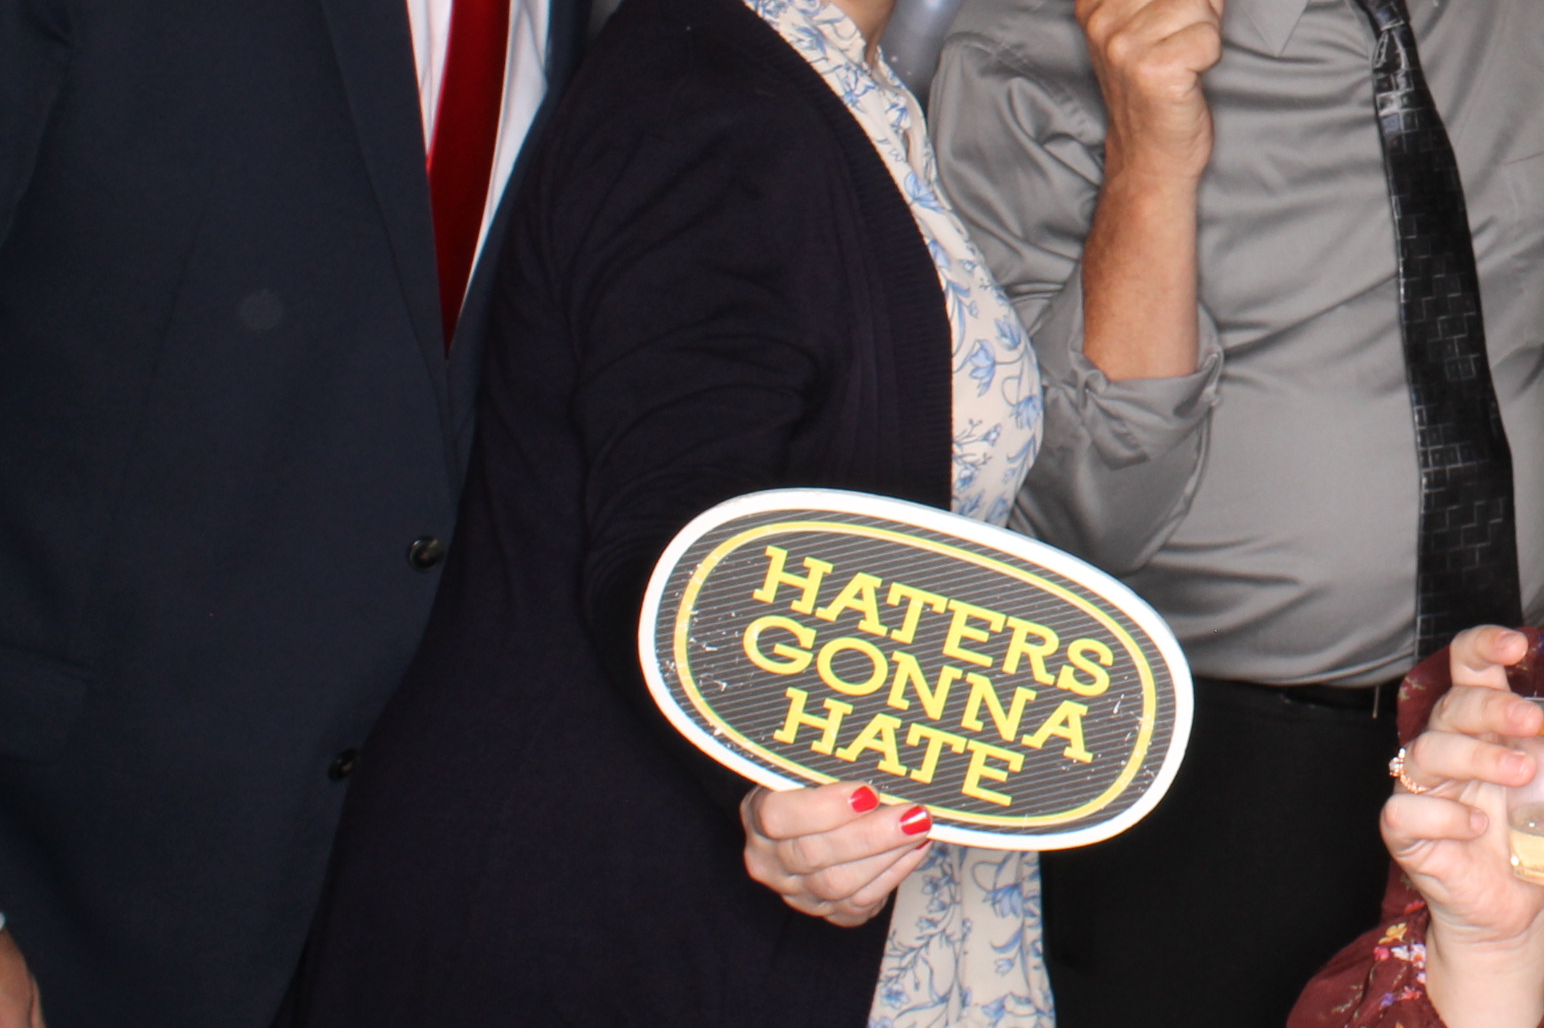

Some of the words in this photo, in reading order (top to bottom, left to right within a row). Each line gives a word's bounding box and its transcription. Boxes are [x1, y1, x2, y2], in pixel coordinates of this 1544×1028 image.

[743, 616, 1094, 763] GONNA
[753, 545, 1115, 696] HATERS
[774, 687, 1025, 806] HATE
